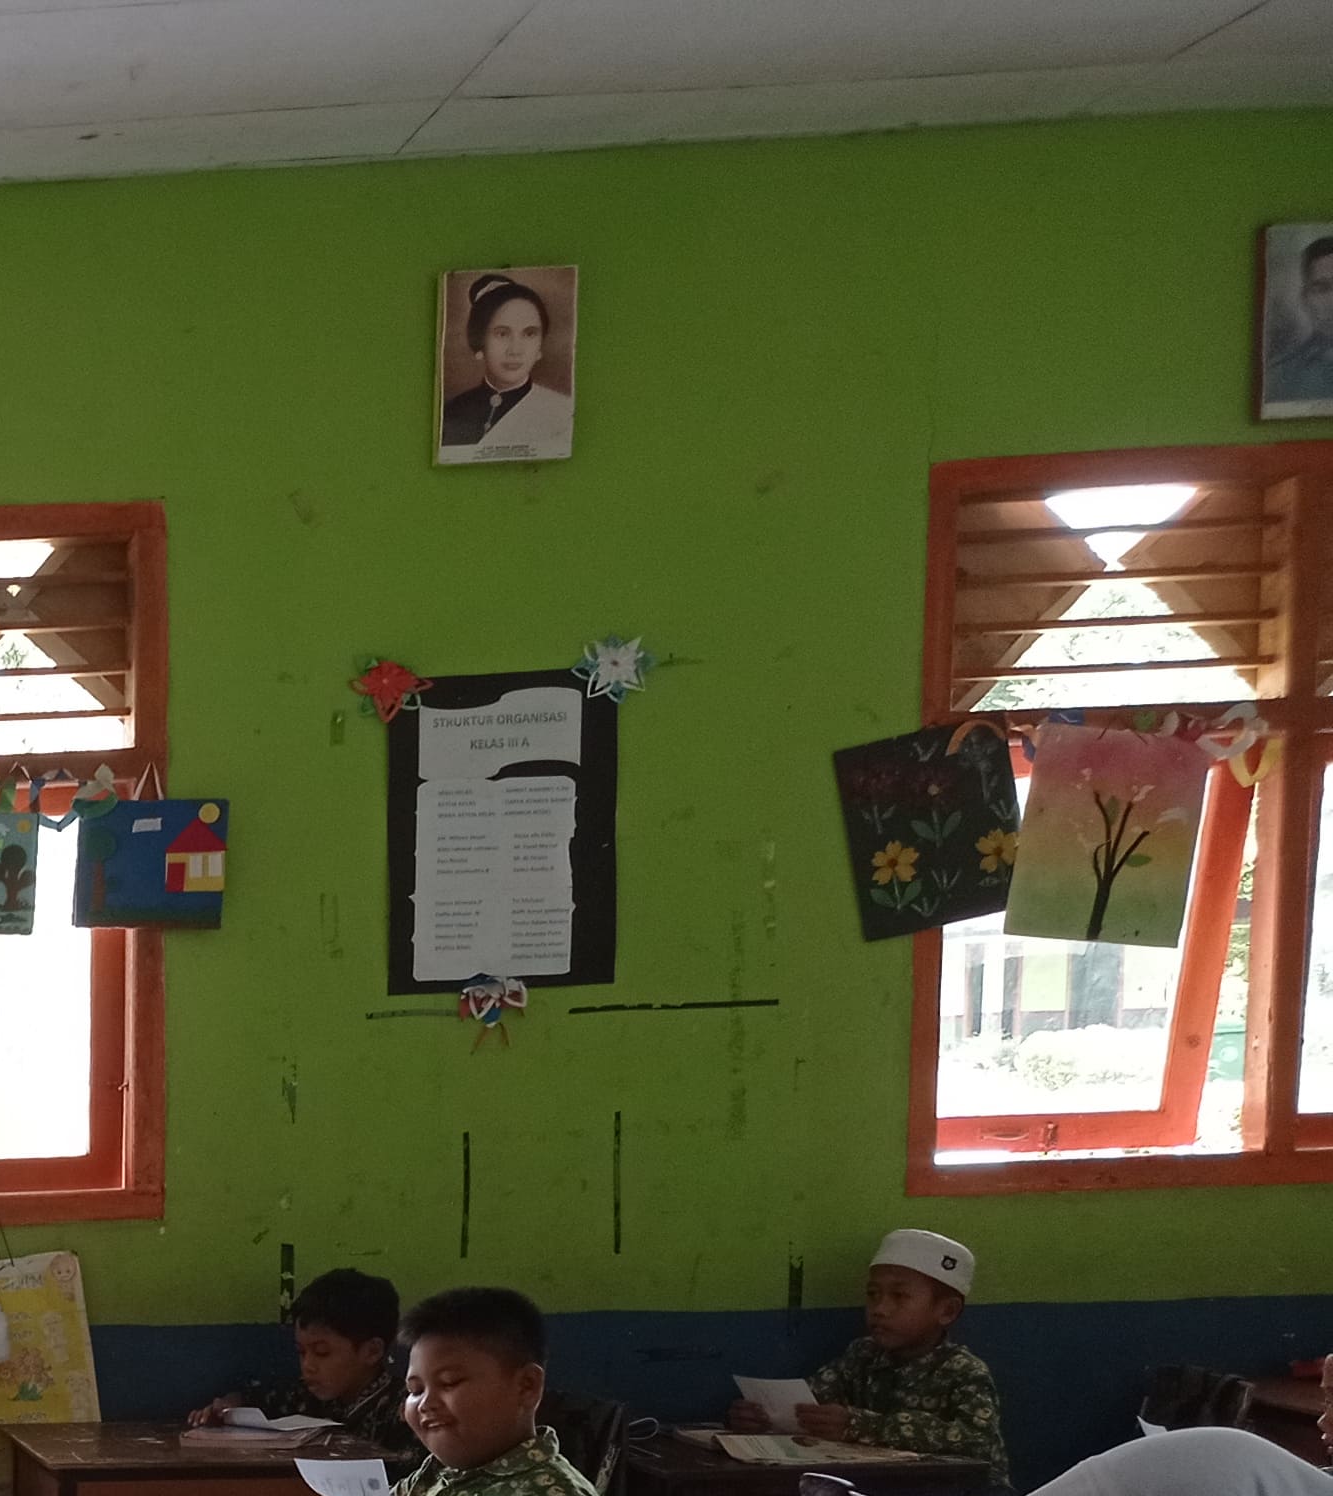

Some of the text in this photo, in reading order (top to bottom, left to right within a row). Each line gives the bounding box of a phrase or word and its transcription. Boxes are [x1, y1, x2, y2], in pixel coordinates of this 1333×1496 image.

[433, 711, 567, 728] STRUKTUR ORGANISASI
[470, 738, 504, 750] KELAS
[521, 736, 530, 748] A
